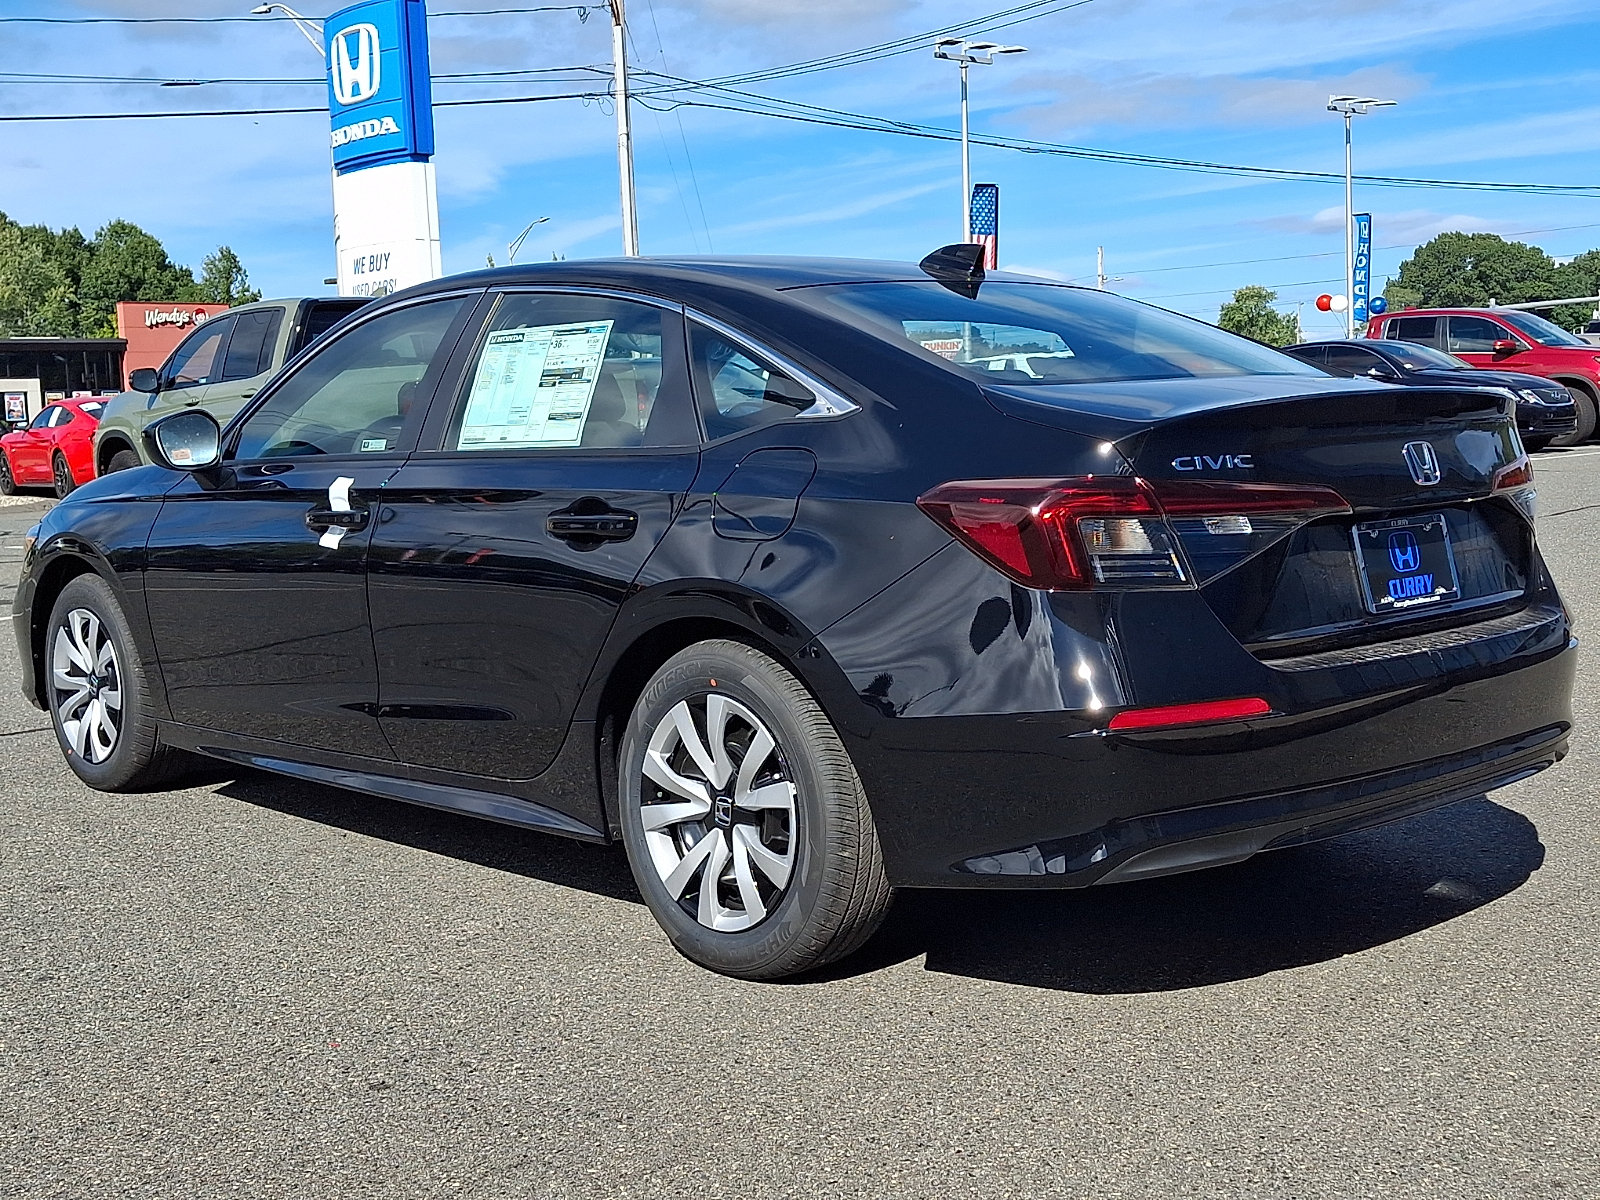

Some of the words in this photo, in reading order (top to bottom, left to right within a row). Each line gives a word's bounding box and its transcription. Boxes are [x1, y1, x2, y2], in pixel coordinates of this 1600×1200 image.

[331, 116, 400, 149] HONDA
[353, 256, 366, 275] WE
[369, 252, 391, 273] BUY
[144, 307, 190, 327] Wendy's
[1171, 454, 1255, 471] CIVIC
[1388, 573, 1433, 599] CURRY
